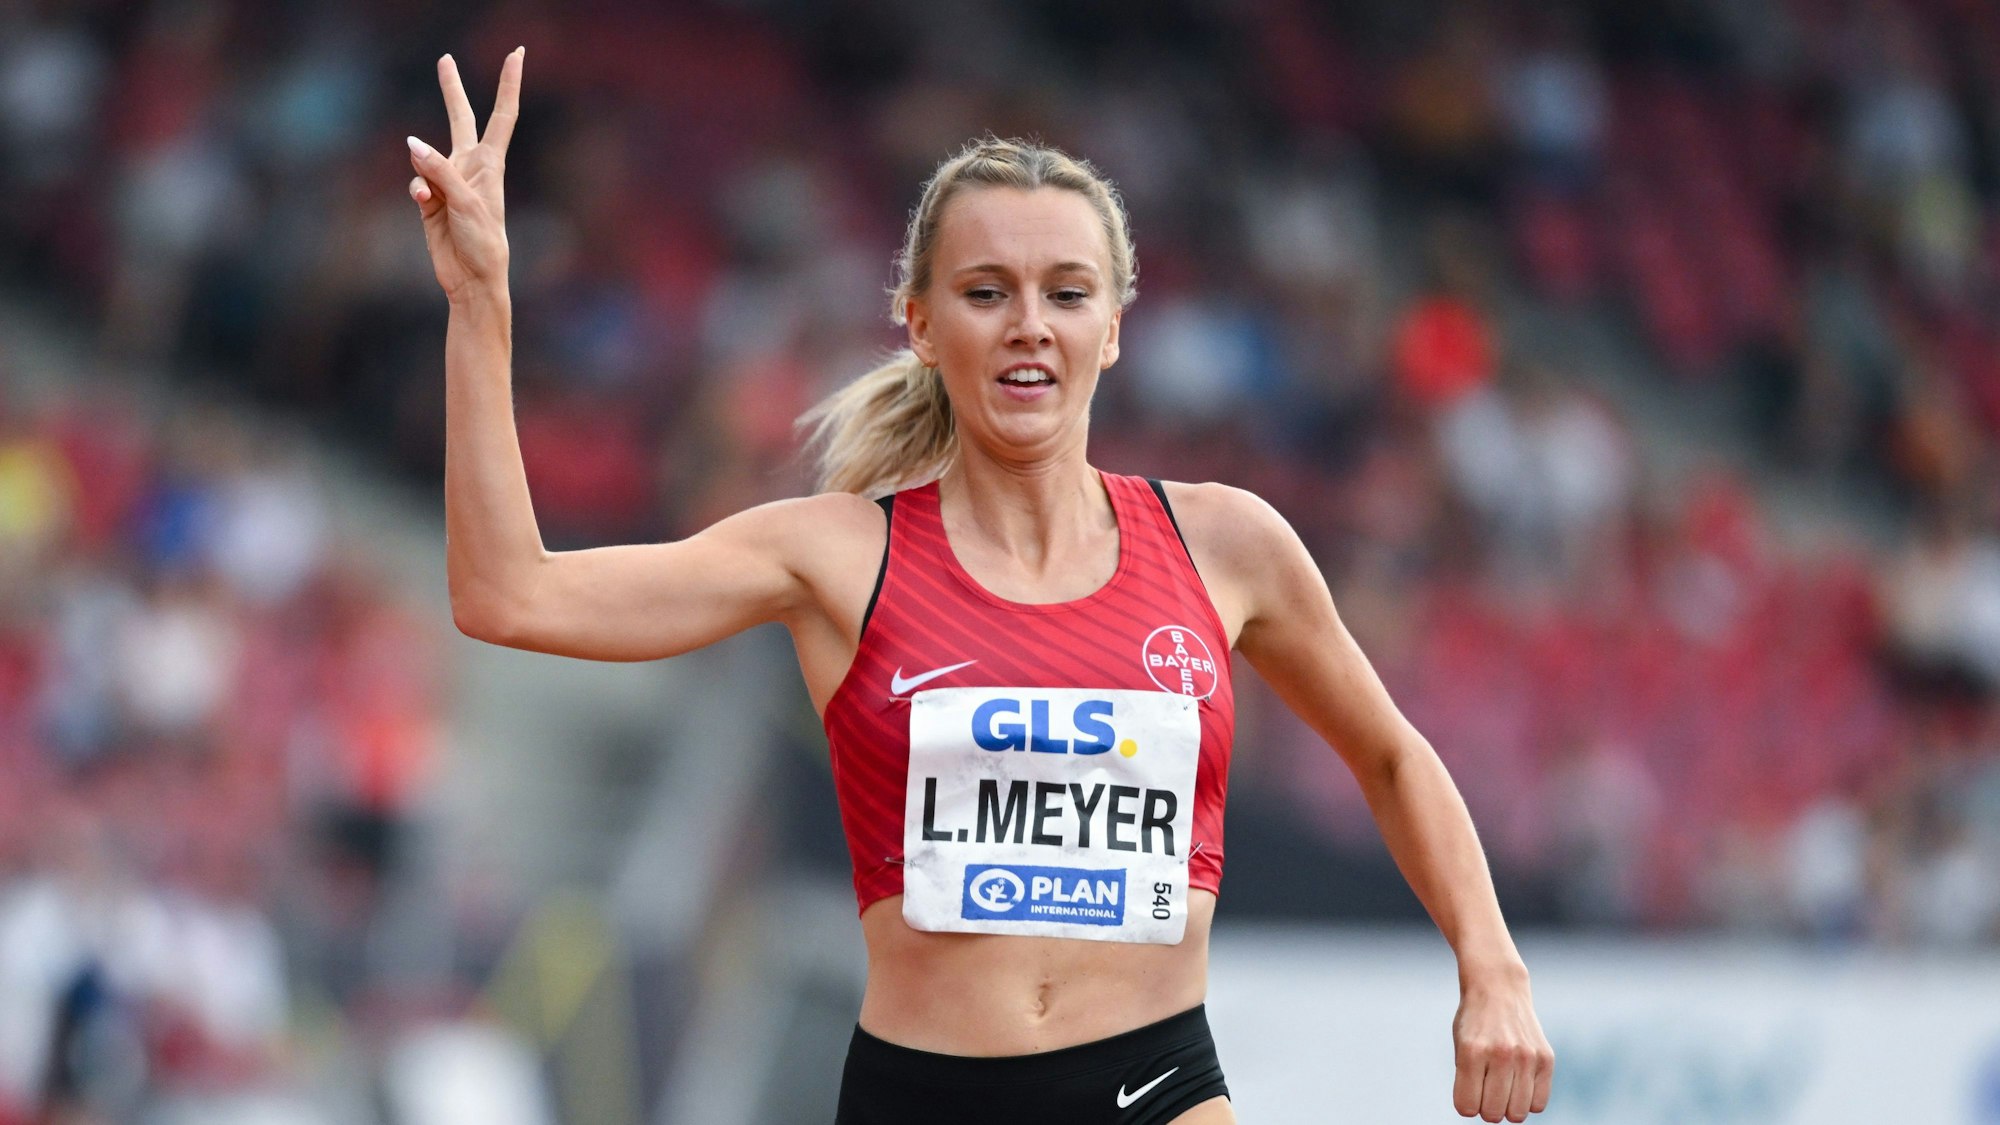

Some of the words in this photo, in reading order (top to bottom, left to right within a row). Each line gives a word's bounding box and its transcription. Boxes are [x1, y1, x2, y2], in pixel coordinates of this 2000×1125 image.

[1149, 653, 1214, 674] BAYER
[1170, 630, 1195, 696] BAYER
[921, 776, 1178, 857] L.MEYER
[1031, 875, 1119, 906] PLAN
[1152, 882, 1172, 920] 540
[1031, 904, 1117, 918] INTERNATIONAL
